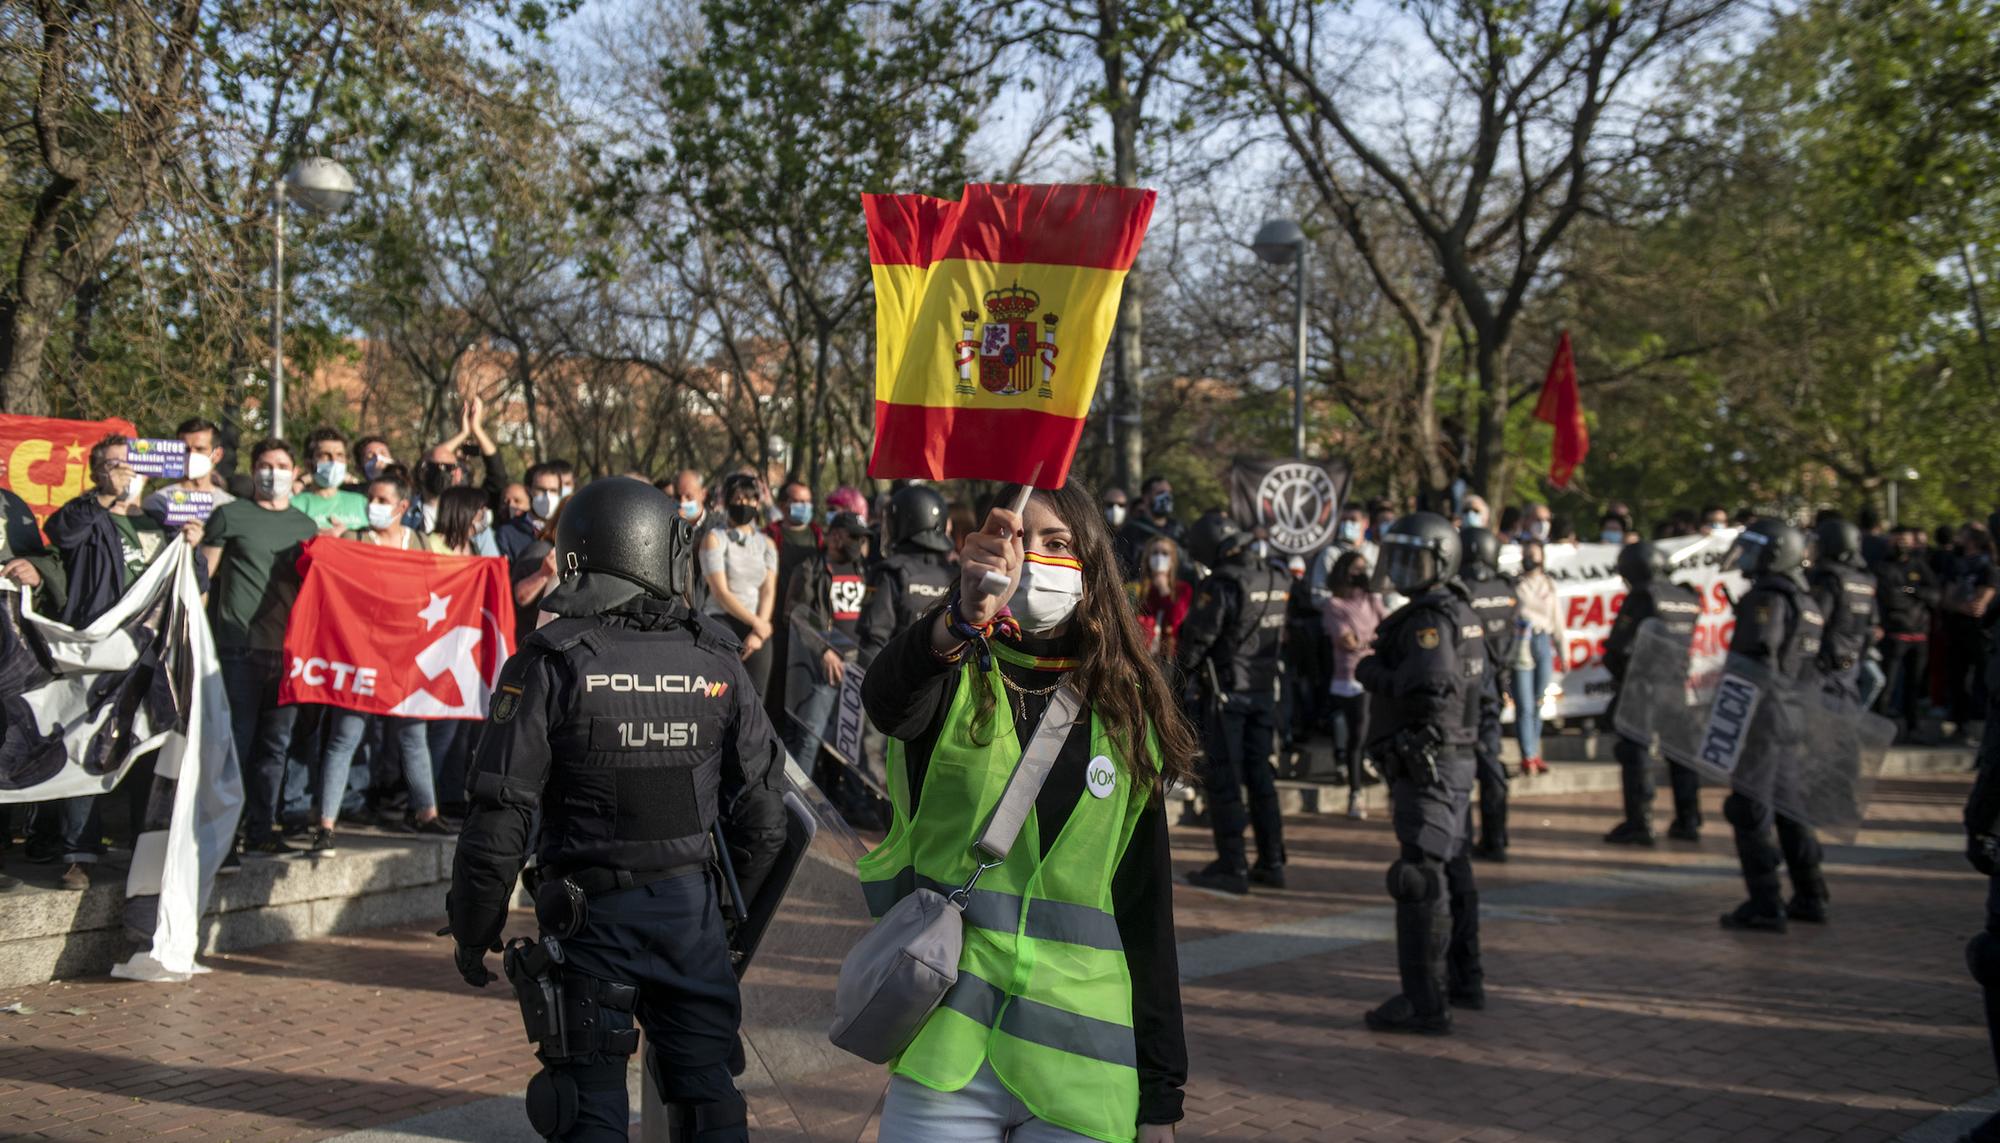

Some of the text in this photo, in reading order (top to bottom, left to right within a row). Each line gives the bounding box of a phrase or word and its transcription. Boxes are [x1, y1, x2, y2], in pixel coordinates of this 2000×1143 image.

[585, 673, 710, 694] POLICIA
[618, 722, 699, 748] 1U451
[838, 667, 863, 763] POLICIA
[1702, 680, 1754, 769] POLICIA
